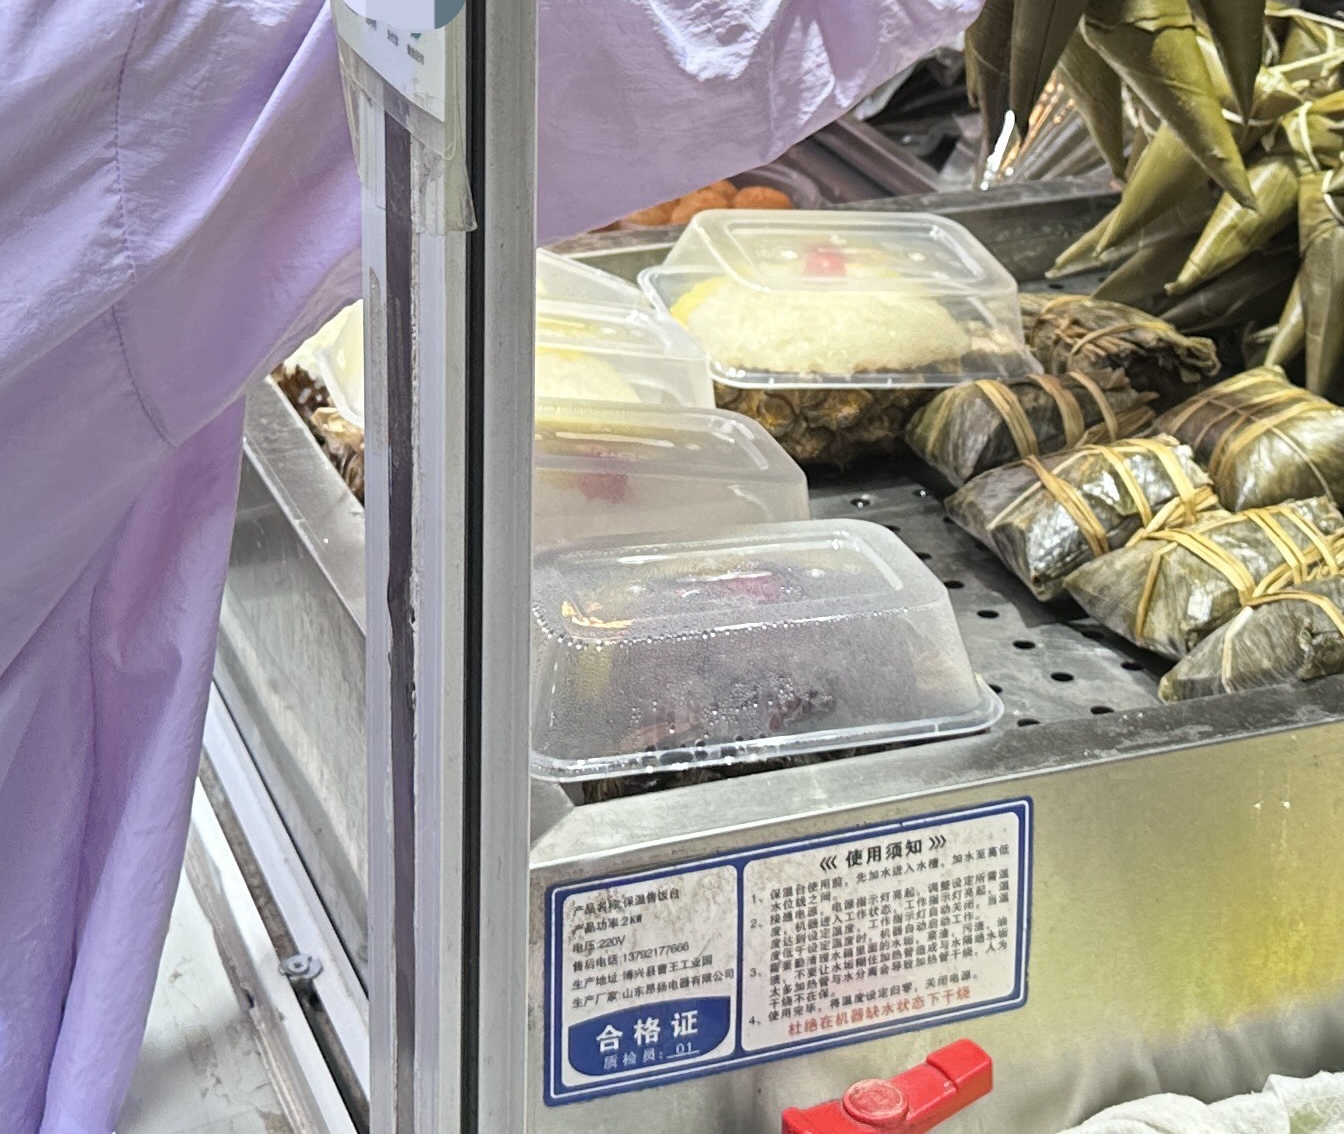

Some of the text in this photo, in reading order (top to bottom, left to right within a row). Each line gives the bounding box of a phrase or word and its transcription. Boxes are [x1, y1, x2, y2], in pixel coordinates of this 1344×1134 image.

[845, 837, 922, 868] 使用须知
[595, 1005, 699, 1055] 合格证
[787, 984, 971, 1038] 杜绝在机器缺水状态下干烧
